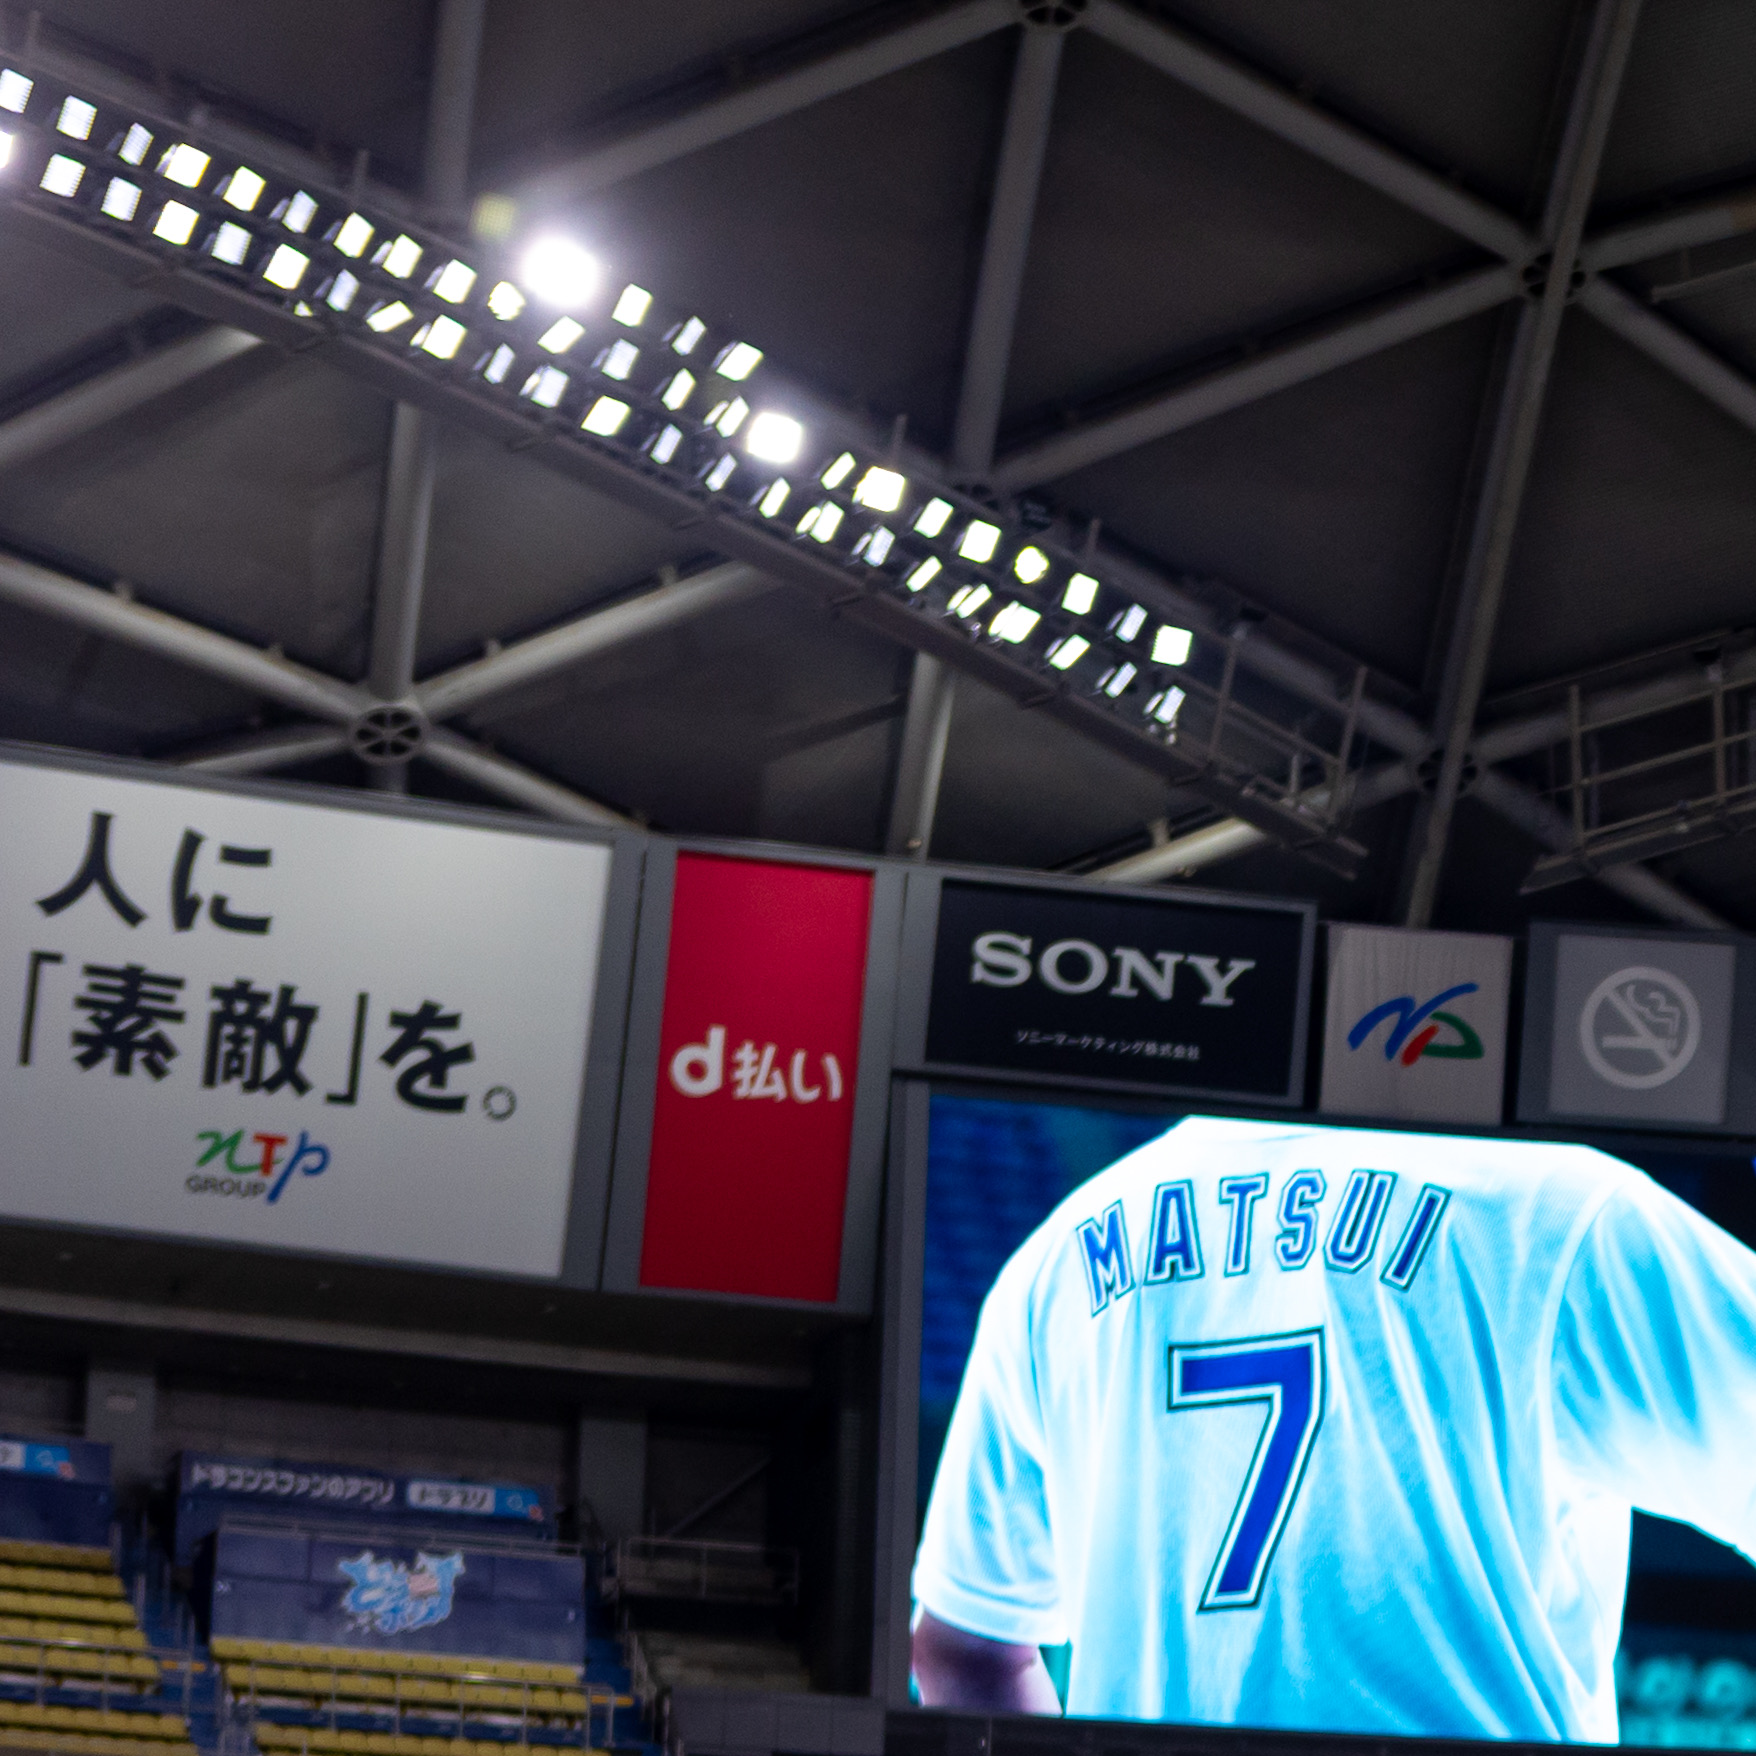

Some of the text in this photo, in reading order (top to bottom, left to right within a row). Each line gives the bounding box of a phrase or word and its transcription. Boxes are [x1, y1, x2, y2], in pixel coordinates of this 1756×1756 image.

[37, 811, 273, 934] 人に
[971, 931, 1255, 1007] SONY
[17, 951, 517, 1122] 「素敵」を。
[669, 1025, 842, 1103] d払い
[1016, 1029, 1200, 1060] ソニーマーケティング株式会社
[186, 1175, 268, 1198] GROUP
[1074, 1168, 1452, 1318] MATSUI
[1168, 1329, 1326, 1615] 7
